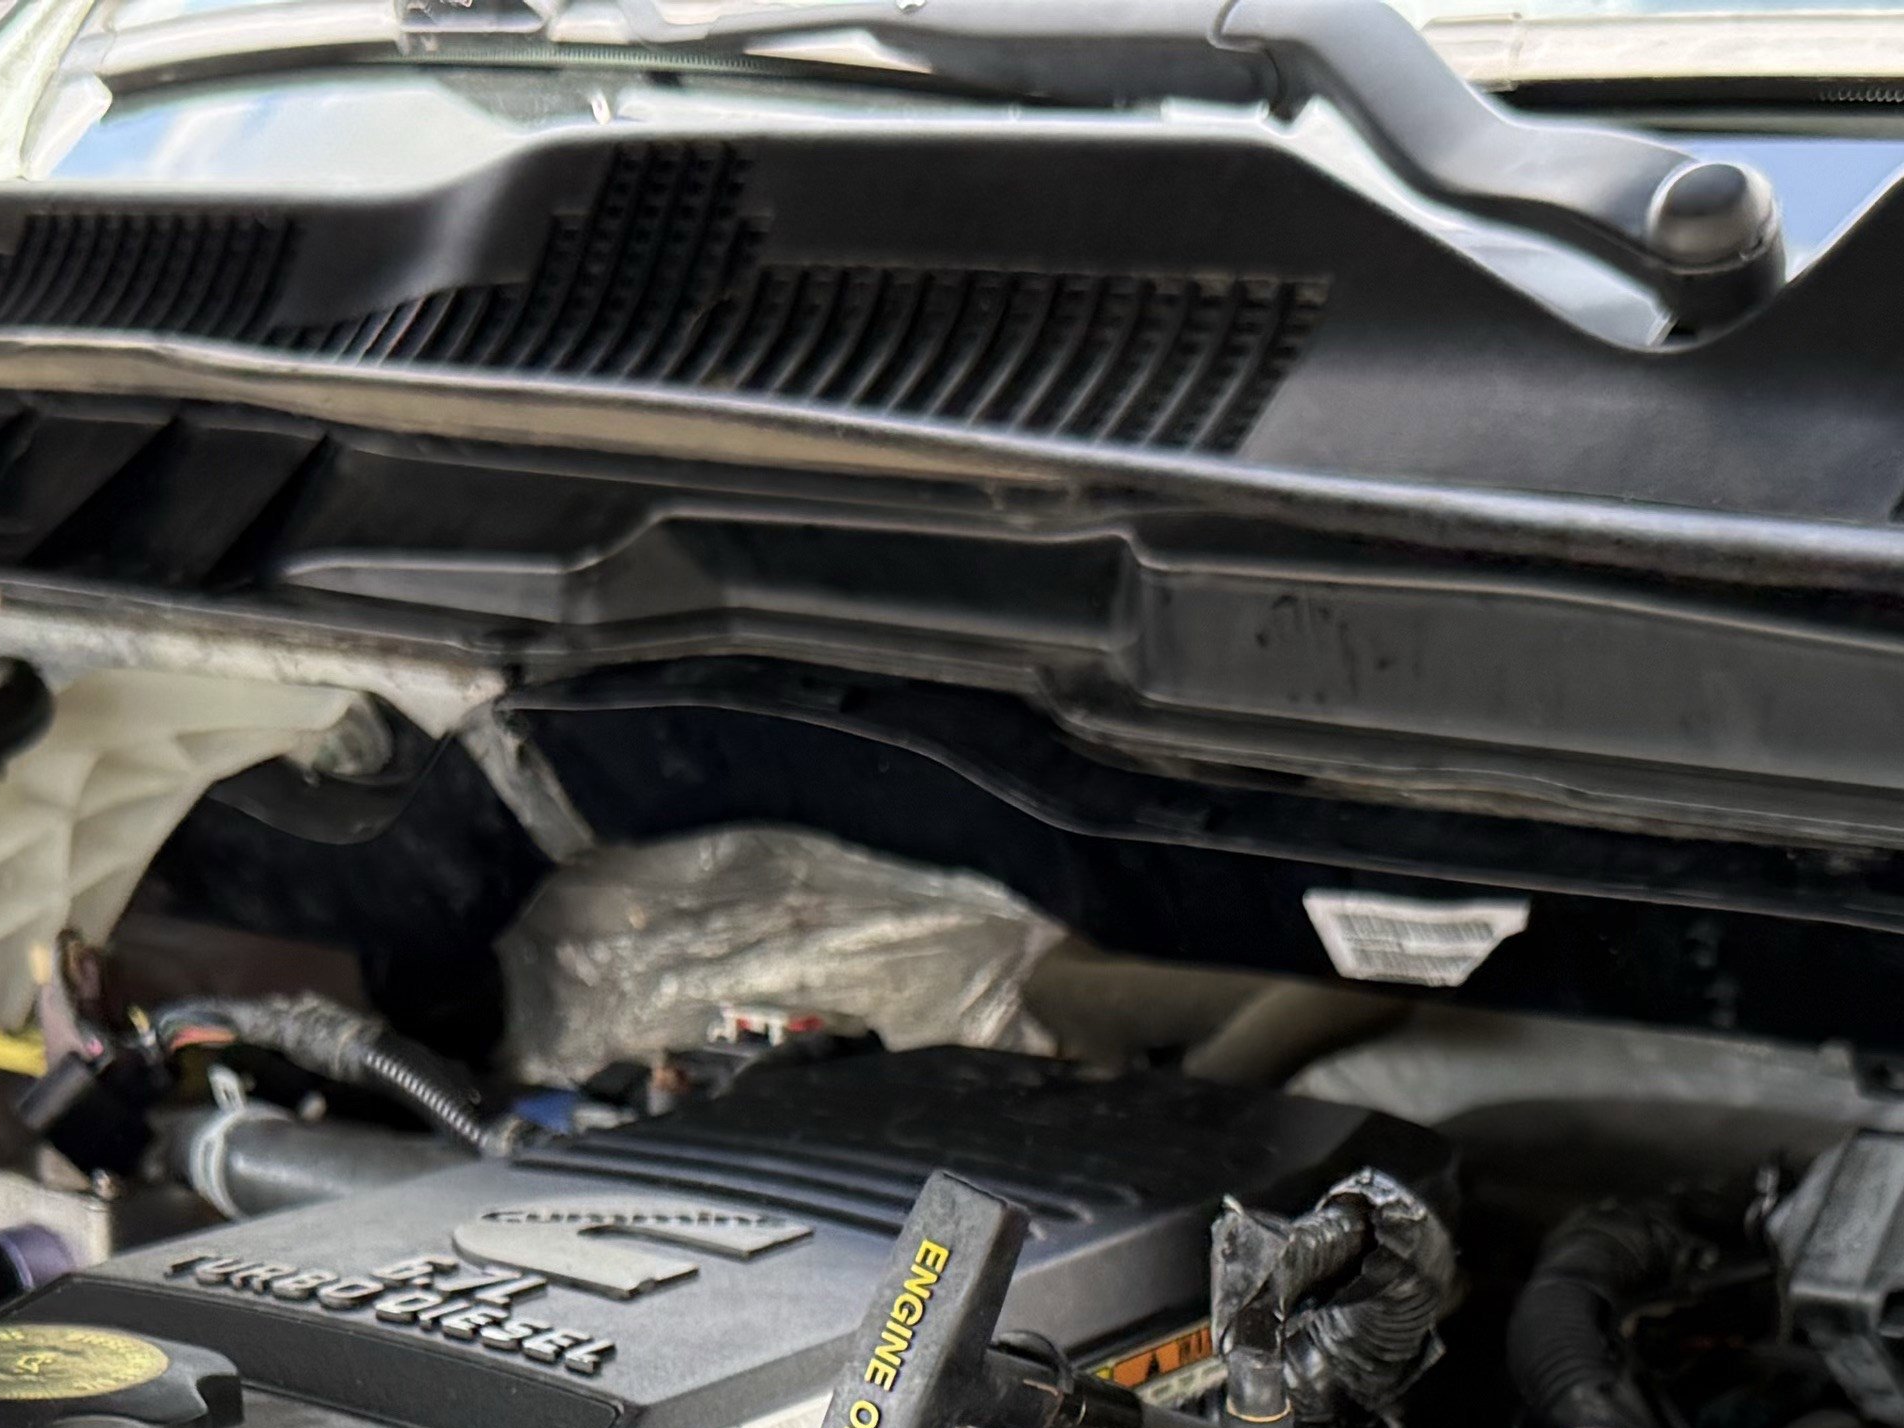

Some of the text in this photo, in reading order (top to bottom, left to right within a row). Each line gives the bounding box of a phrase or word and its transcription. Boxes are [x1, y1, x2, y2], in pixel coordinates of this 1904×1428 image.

[164, 1248, 616, 1374] TURBO DIESEL
[864, 1239, 949, 1391] ENGINE
